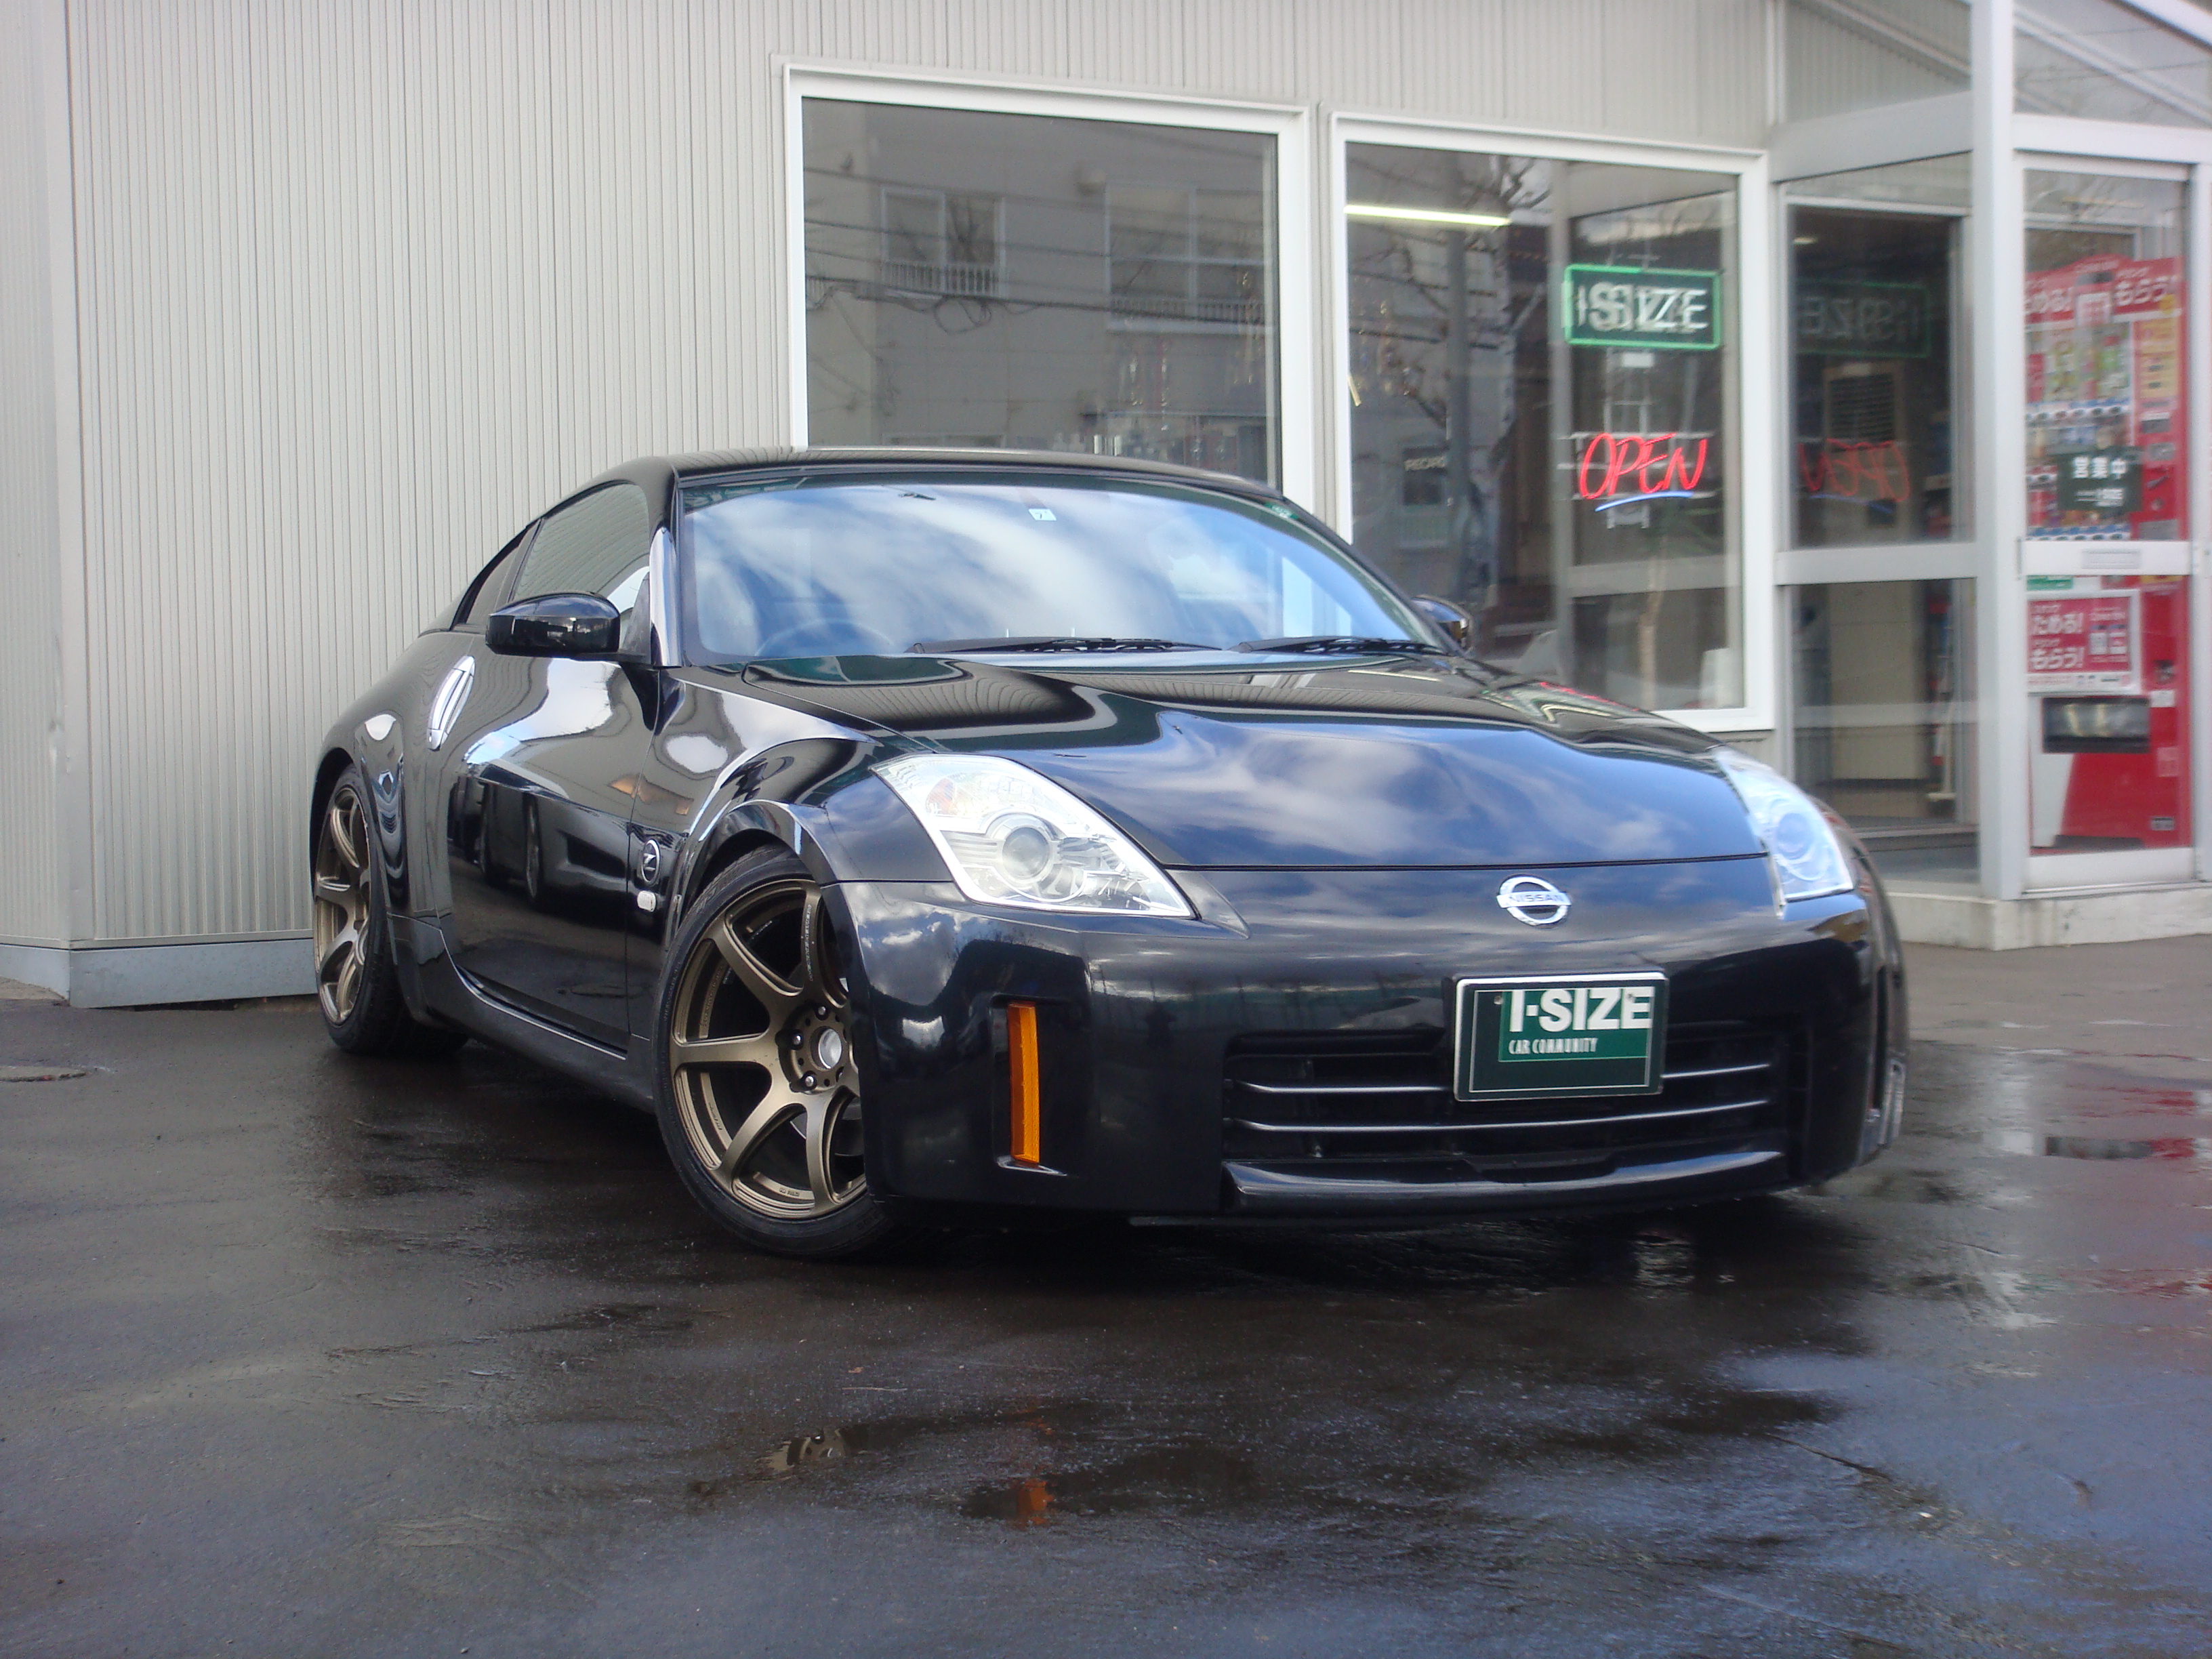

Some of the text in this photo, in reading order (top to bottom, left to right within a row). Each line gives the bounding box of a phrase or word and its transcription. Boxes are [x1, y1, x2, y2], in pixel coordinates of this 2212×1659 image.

[1580, 432, 1708, 499] OPEN
[1509, 893, 1565, 903] NISSAN
[1509, 986, 1655, 1033] I-SIZE
[1508, 1038, 1599, 1055] CAR COMMUNITY
